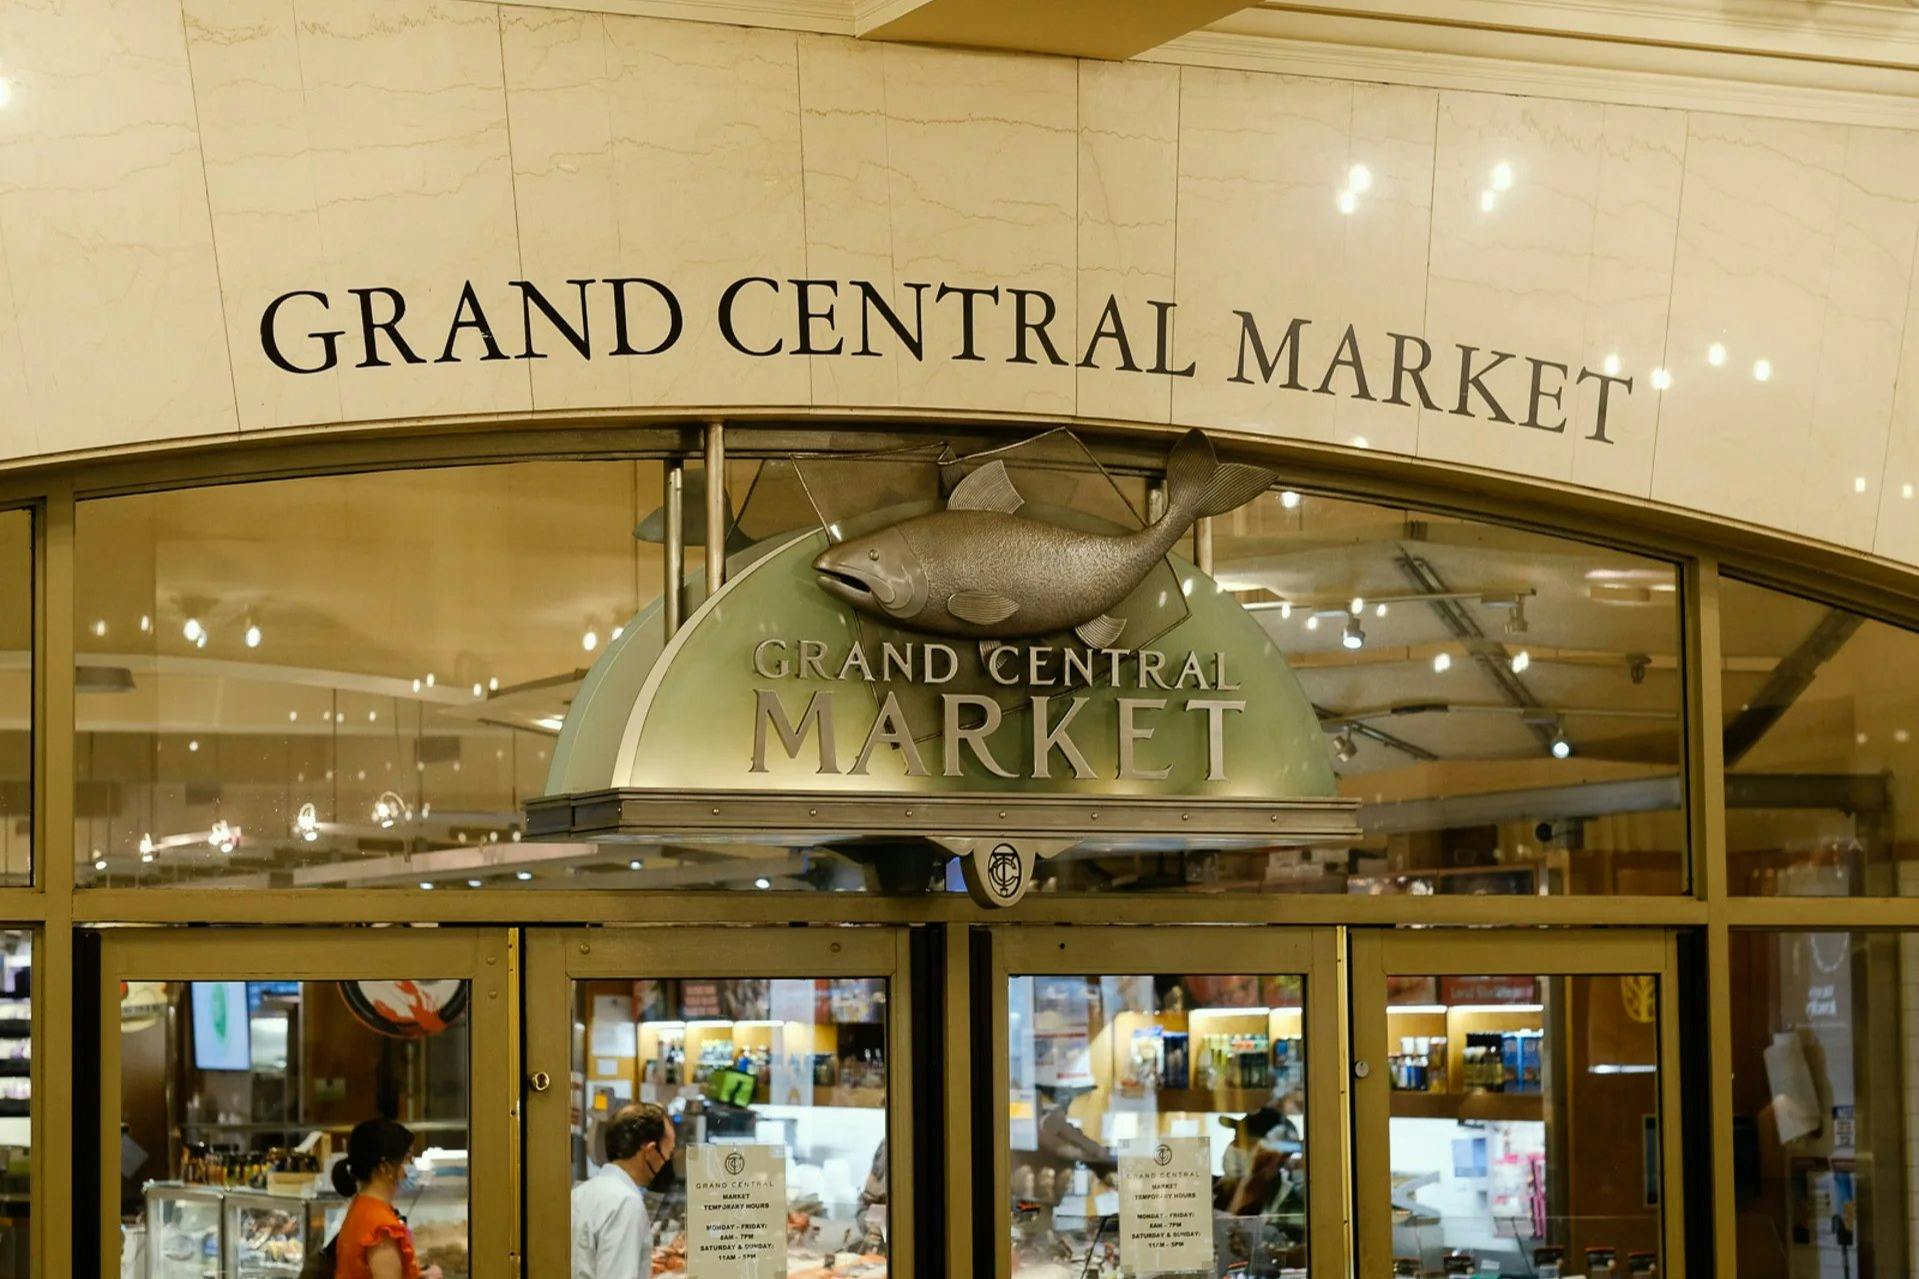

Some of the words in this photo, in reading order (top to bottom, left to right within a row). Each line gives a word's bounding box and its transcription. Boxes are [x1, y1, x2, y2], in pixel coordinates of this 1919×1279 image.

[260, 278, 684, 374] GRAND
[717, 275, 1197, 378] CENTRAL
[1226, 309, 1634, 446] MARKET
[752, 638, 959, 684] GRAND
[988, 644, 1242, 692] CENTRAL
[748, 687, 1247, 782] MARKET
